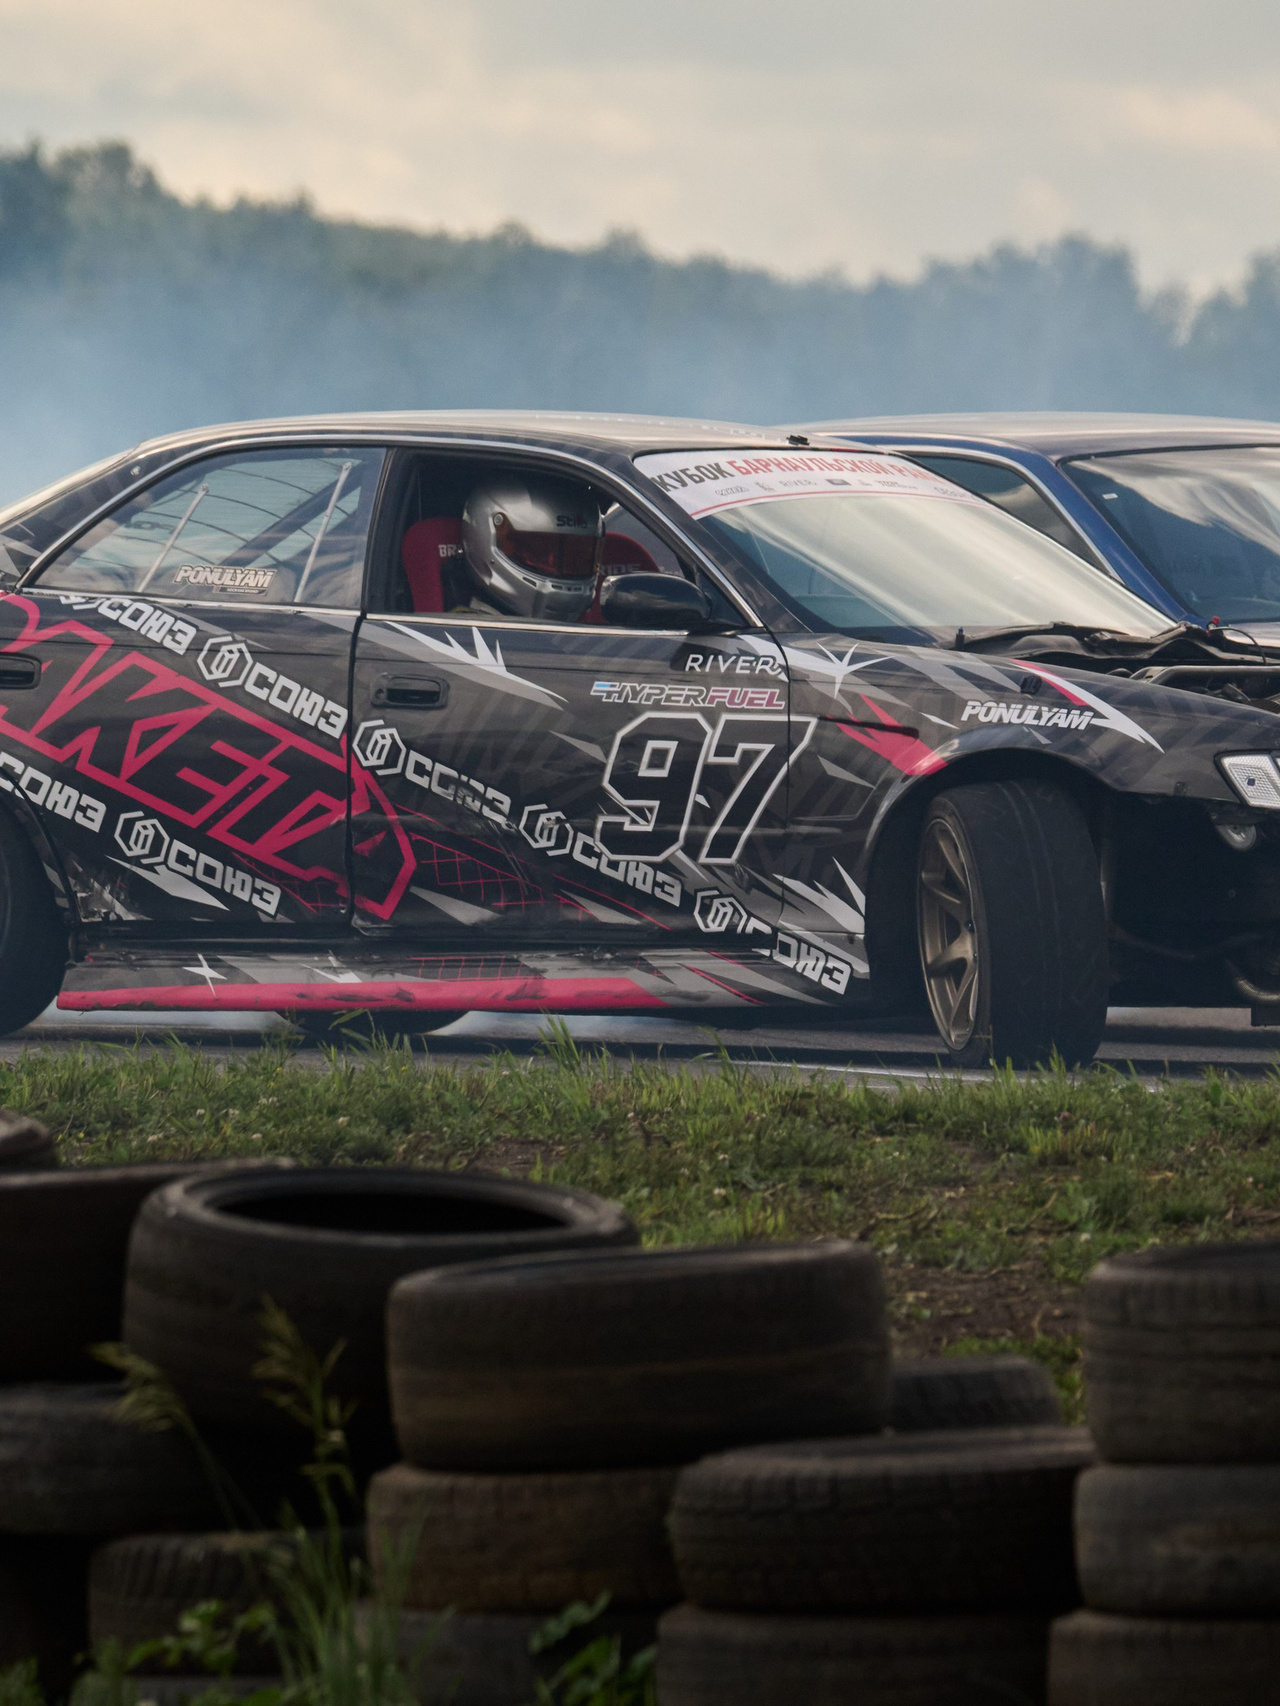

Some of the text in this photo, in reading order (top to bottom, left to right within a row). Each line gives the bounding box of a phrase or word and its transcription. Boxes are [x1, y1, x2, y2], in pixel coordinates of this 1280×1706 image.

[651, 462, 735, 492] КУБОК
[726, 457, 893, 476] БАРНАУЛЬСКОЙ
[174, 565, 276, 588] PONULYAM
[685, 654, 782, 676] RIVER
[244, 664, 348, 739] СОЮЗ
[590, 681, 785, 709] HYPERFUEL
[961, 701, 1094, 730] PONULYAM
[594, 711, 818, 864] 97
[167, 839, 282, 917] СОЮЗ
